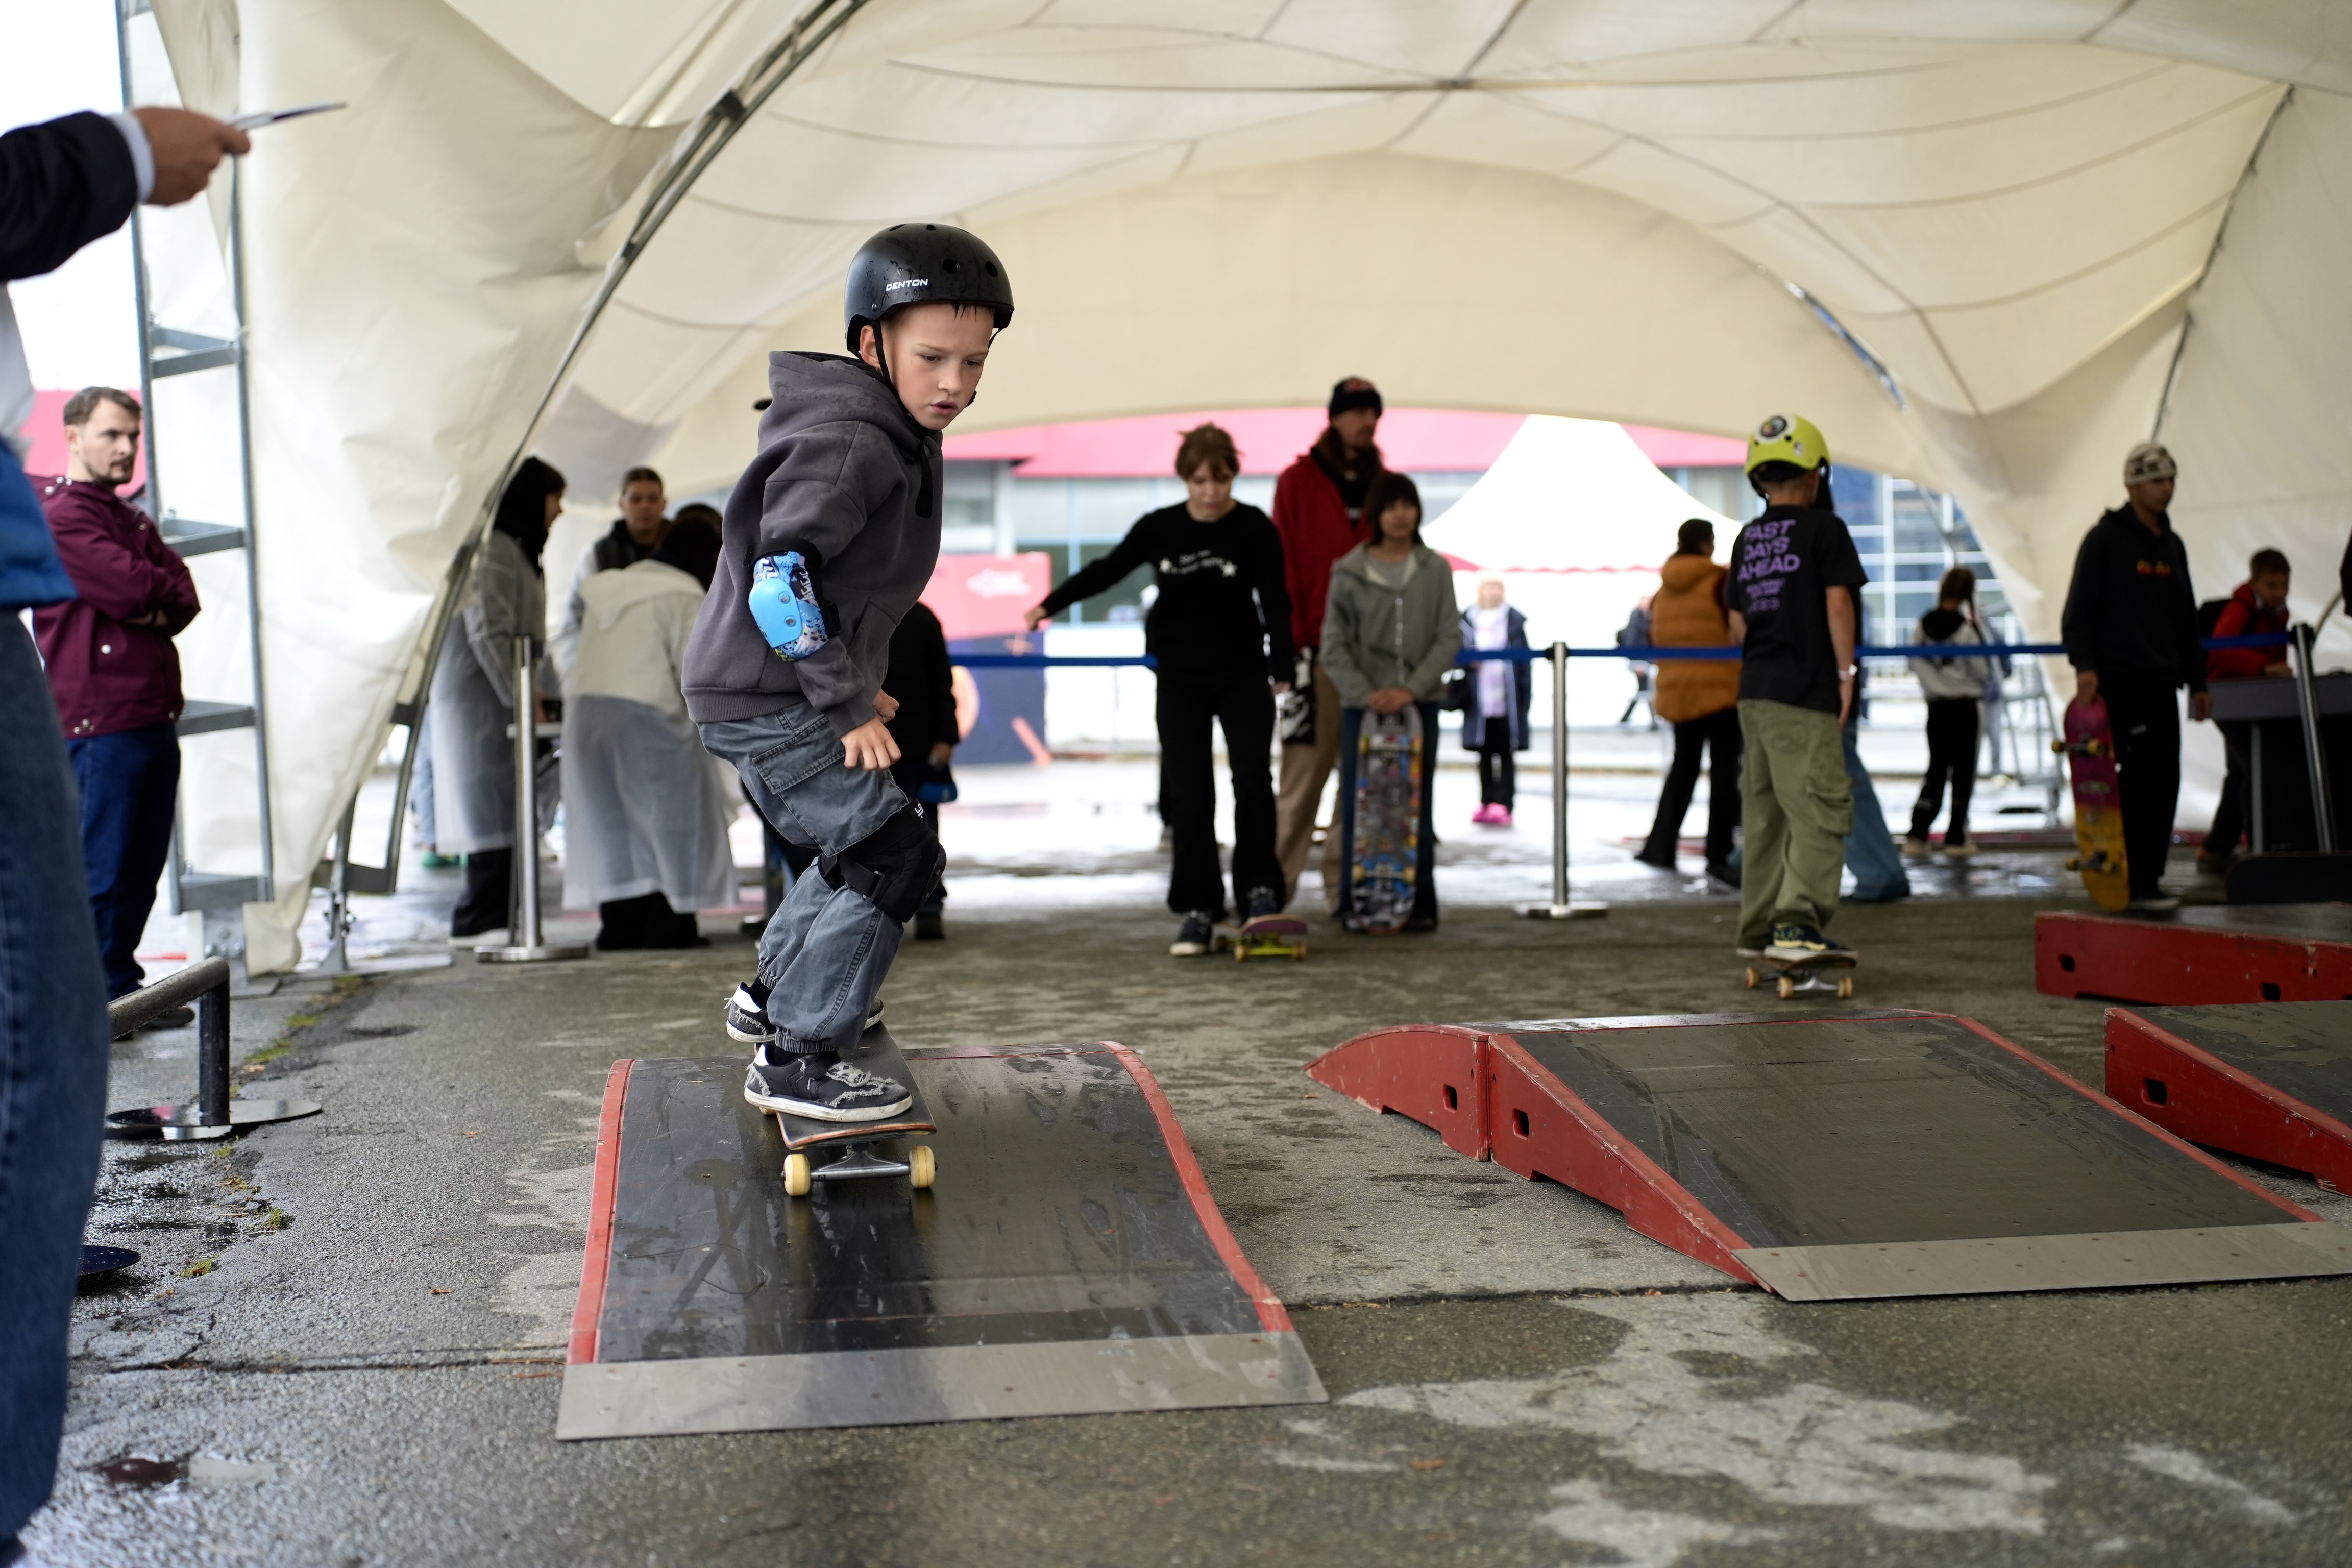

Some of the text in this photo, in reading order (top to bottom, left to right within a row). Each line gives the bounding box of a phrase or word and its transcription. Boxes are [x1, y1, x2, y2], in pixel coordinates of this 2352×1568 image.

[886, 278, 928, 292] DENTON
[1744, 518, 1797, 542] FAST
[1743, 536, 1790, 562] DAYS
[1736, 553, 1801, 583] AHEAD
